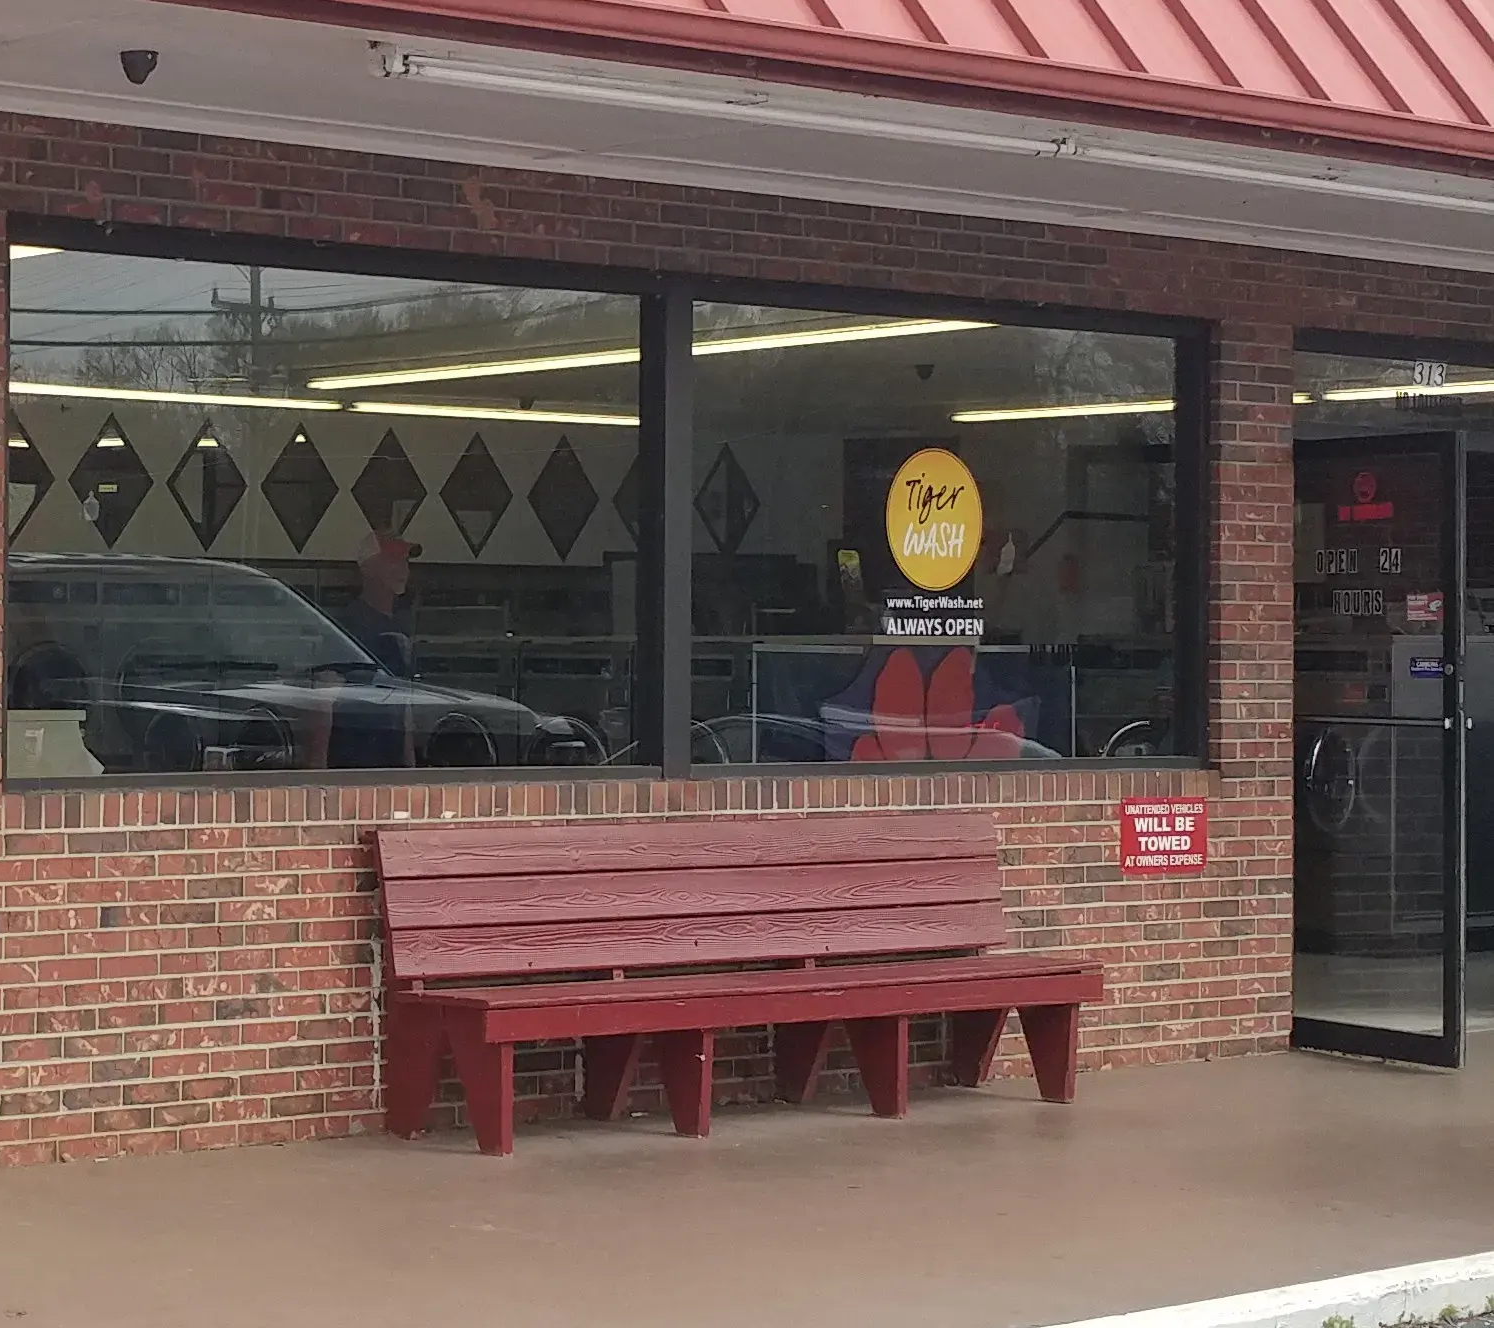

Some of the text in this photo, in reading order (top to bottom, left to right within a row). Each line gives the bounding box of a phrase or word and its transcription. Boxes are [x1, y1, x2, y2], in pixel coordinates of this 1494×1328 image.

[1414, 363, 1444, 386] 313
[906, 473, 965, 524] Tiger
[903, 522, 966, 559] WASH
[1316, 548, 1401, 573] OPEN 24
[887, 596, 984, 611] www.TigerWash.net
[1333, 590, 1382, 614] HOURS
[887, 619, 984, 635] ALWAYS OPEN
[1125, 804, 1203, 815] UNATTENDED VEHICLES
[1134, 817, 1195, 832] WILL BE
[1138, 836, 1191, 851] TOWED
[1125, 854, 1203, 867] AT OWNERS EXPENSE
